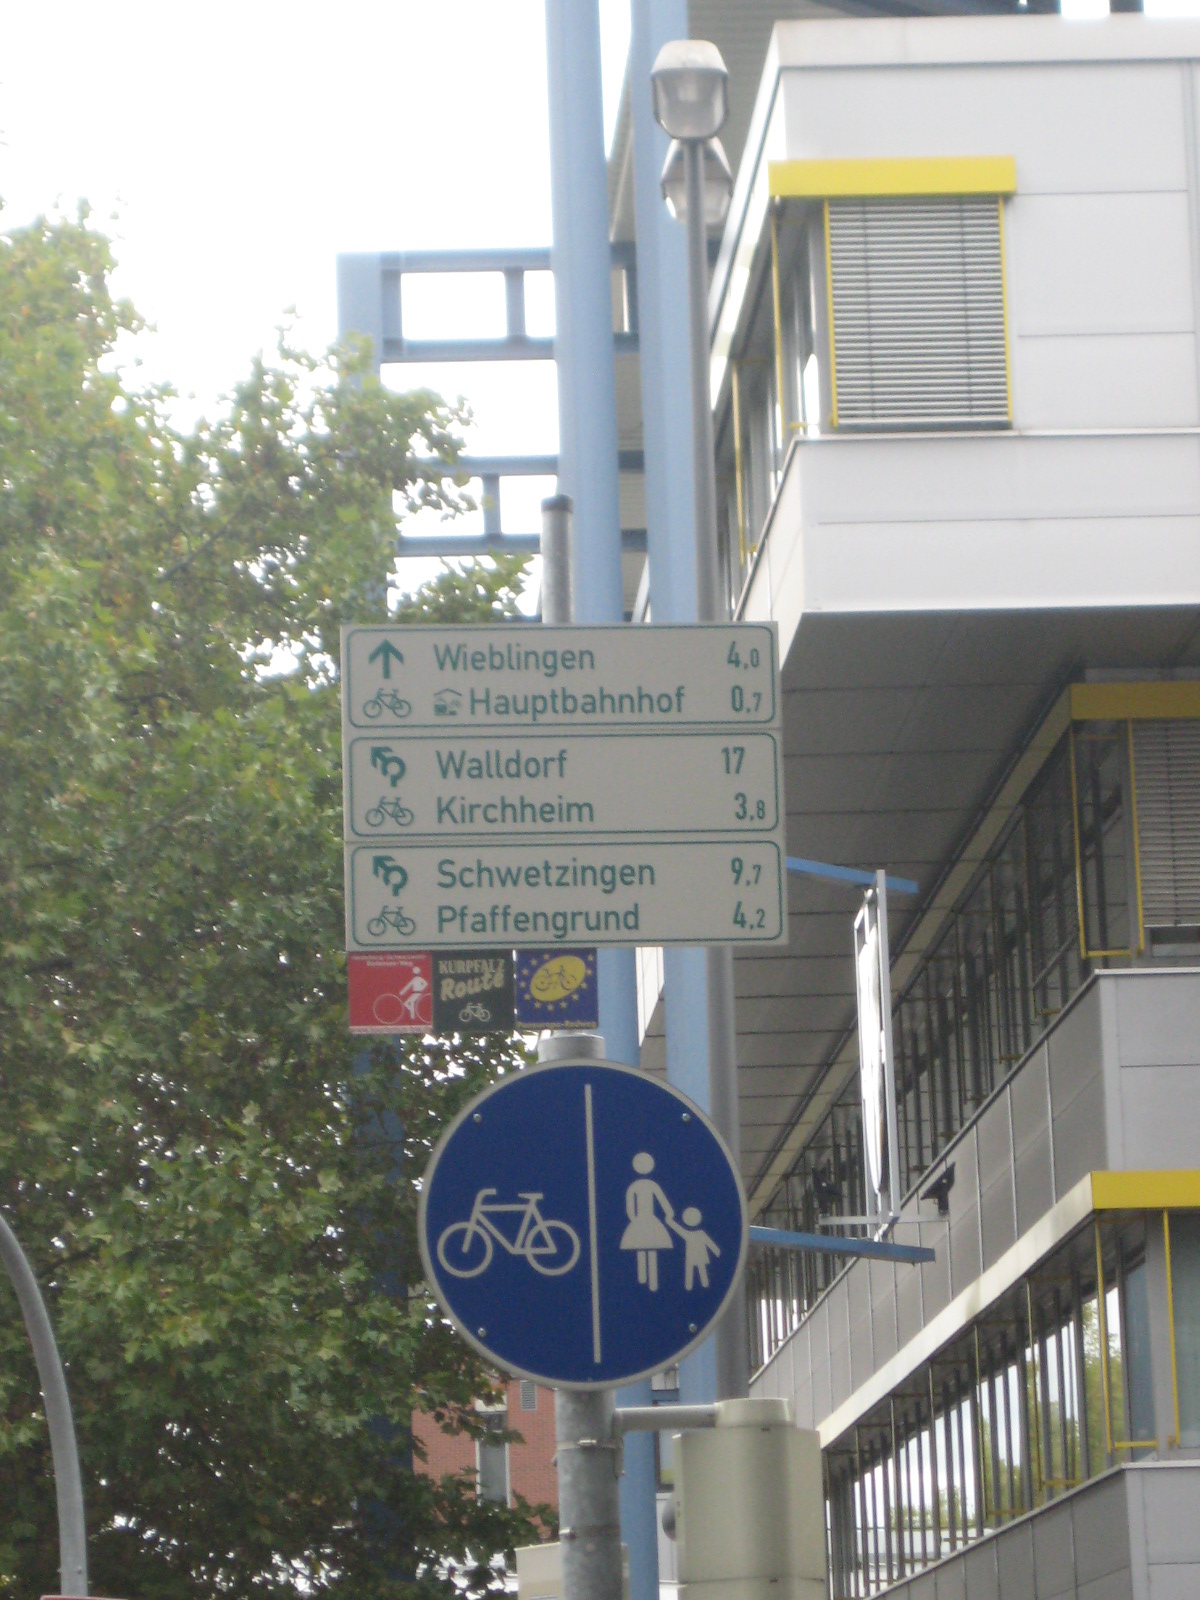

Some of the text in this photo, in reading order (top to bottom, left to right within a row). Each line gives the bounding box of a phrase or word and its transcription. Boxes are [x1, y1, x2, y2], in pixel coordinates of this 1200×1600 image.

[433, 642, 595, 678] Wieblingen
[469, 685, 685, 722] Hauptbahnhof
[435, 746, 745, 779] Walldorf 17
[437, 794, 594, 824] Kirchheim
[437, 858, 656, 895] Schwetzingen
[437, 903, 640, 940] Pfaffengrund
[440, 971, 505, 1002] Route
